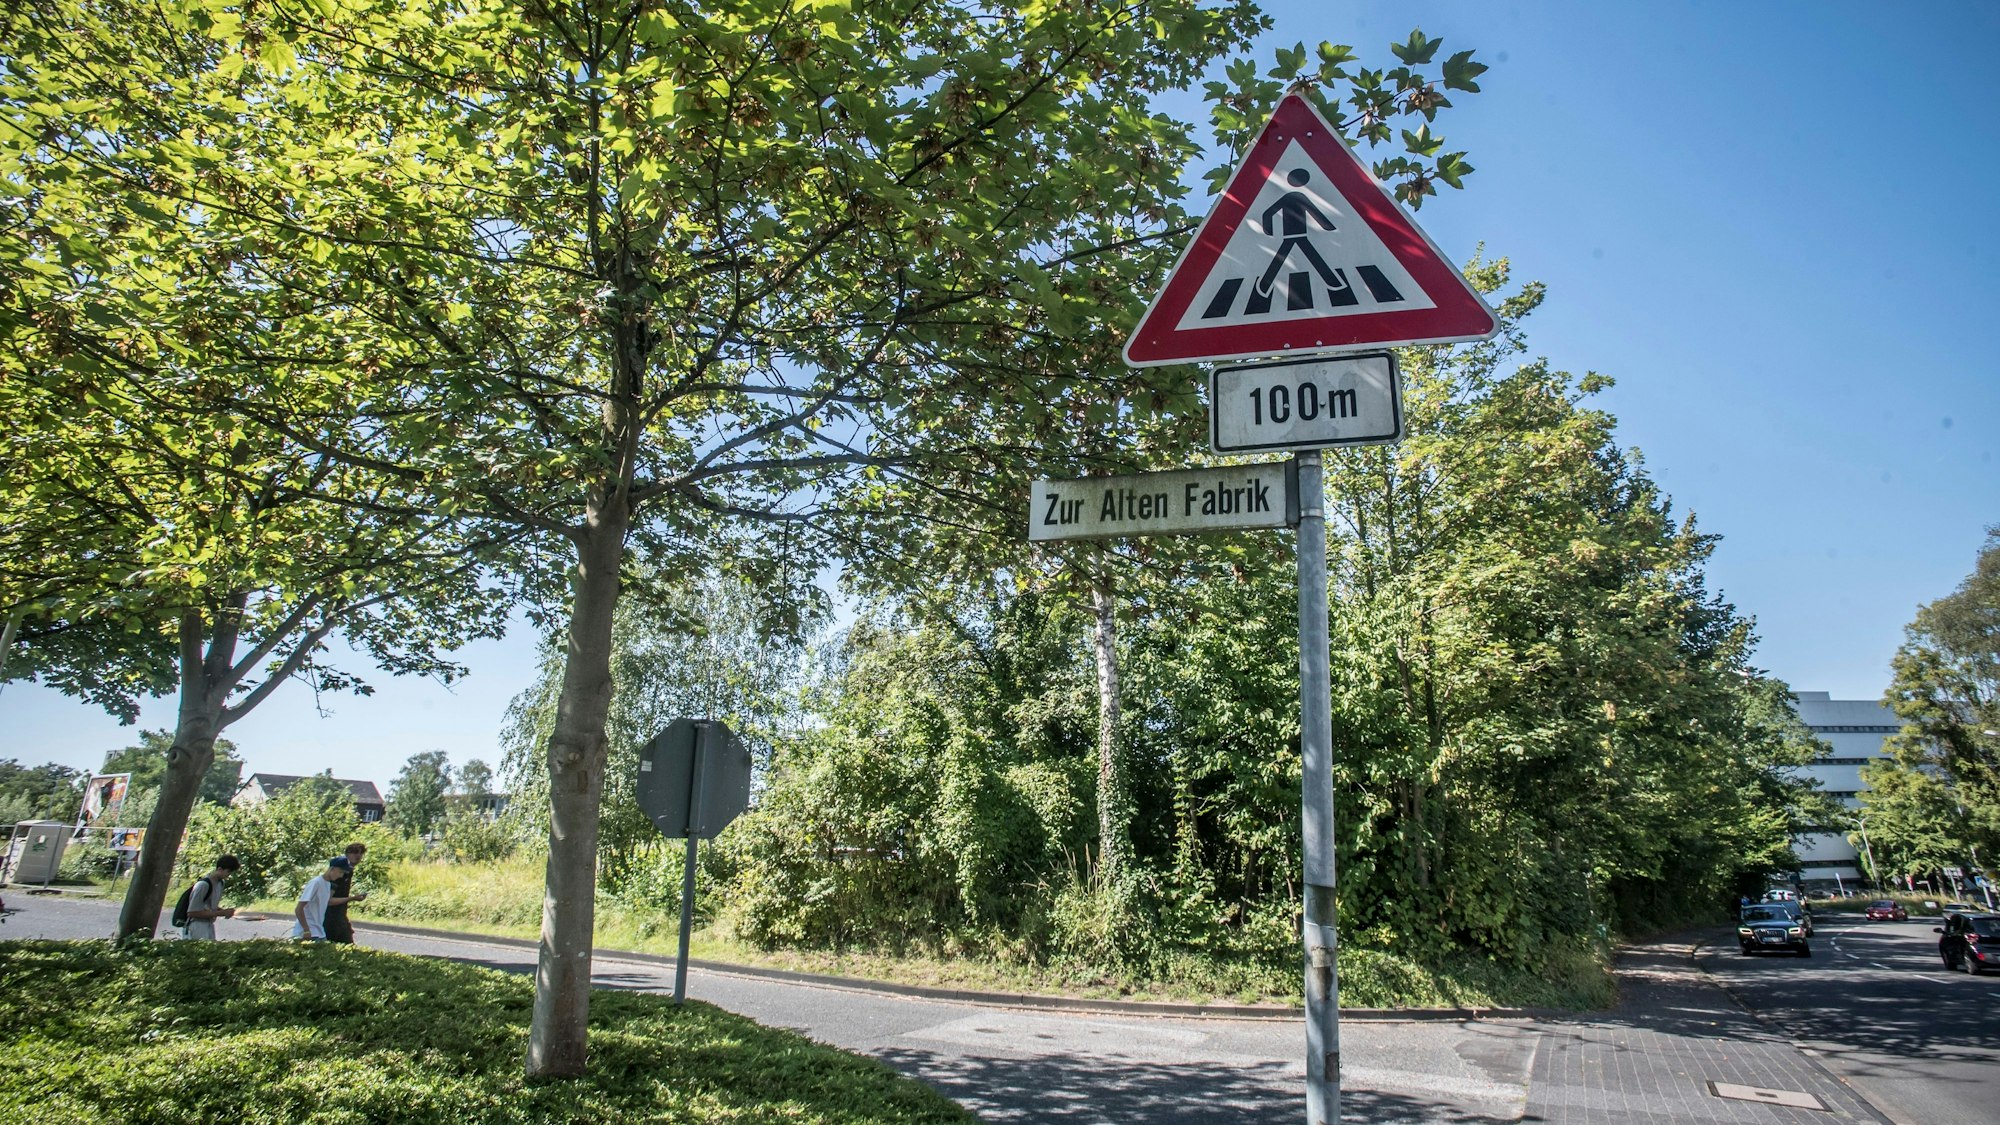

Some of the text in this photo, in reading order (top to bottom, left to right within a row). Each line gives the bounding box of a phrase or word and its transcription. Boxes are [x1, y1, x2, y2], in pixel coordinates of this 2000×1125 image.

[1043, 478, 1271, 526] Zur Alten Fabrik
